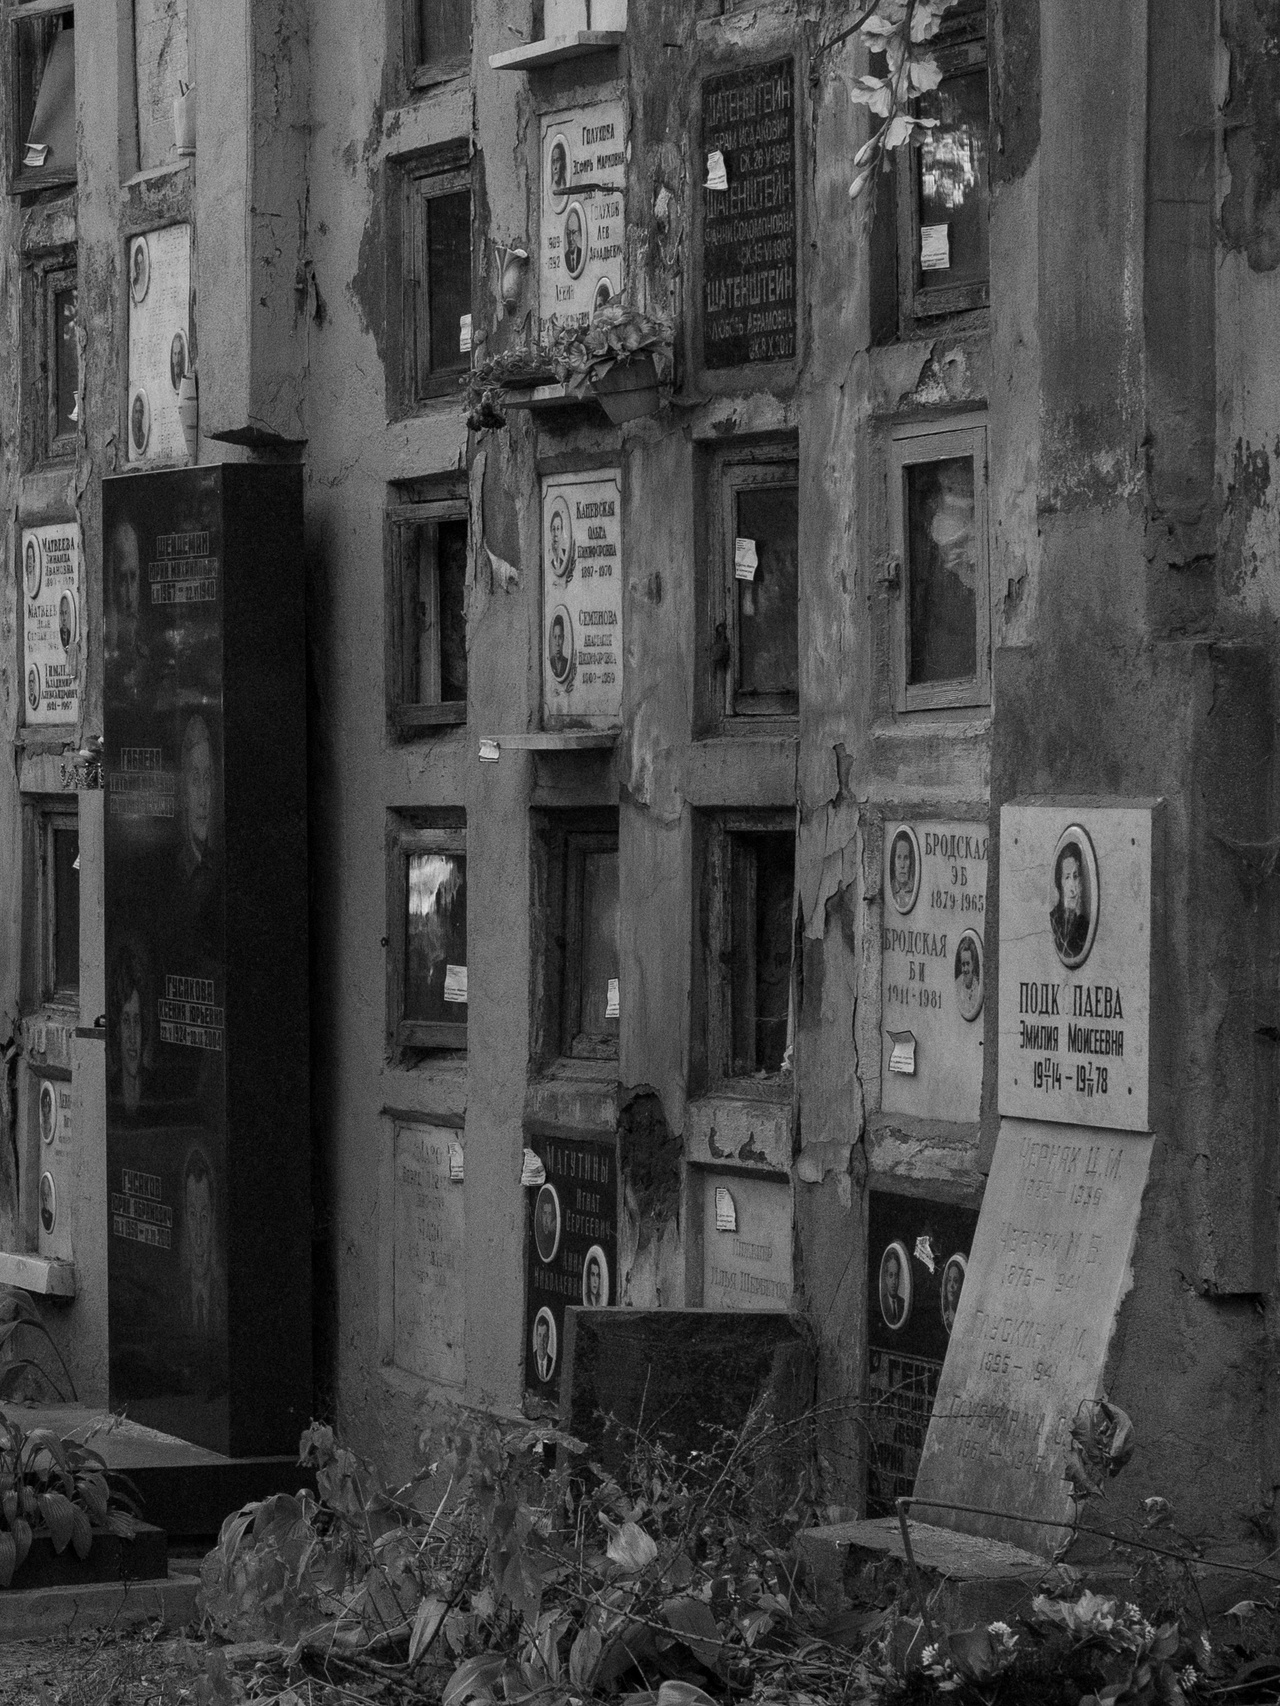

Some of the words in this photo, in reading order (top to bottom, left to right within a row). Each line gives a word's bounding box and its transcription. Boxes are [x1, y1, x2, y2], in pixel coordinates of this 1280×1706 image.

[707, 264, 792, 312] ШАТЕНШТЕЙН
[924, 832, 989, 862] БРОДСКАЯ
[883, 928, 948, 959] БРОДСКАЯ
[1019, 982, 1124, 1019] ПОДКПАЕВА
[1019, 1020, 1059, 1052] ЭМИЛИЯ
[1068, 1023, 1124, 1056] МОИСЕЕВНА
[1020, 1136, 1082, 1174] ЧЕРНЯК
